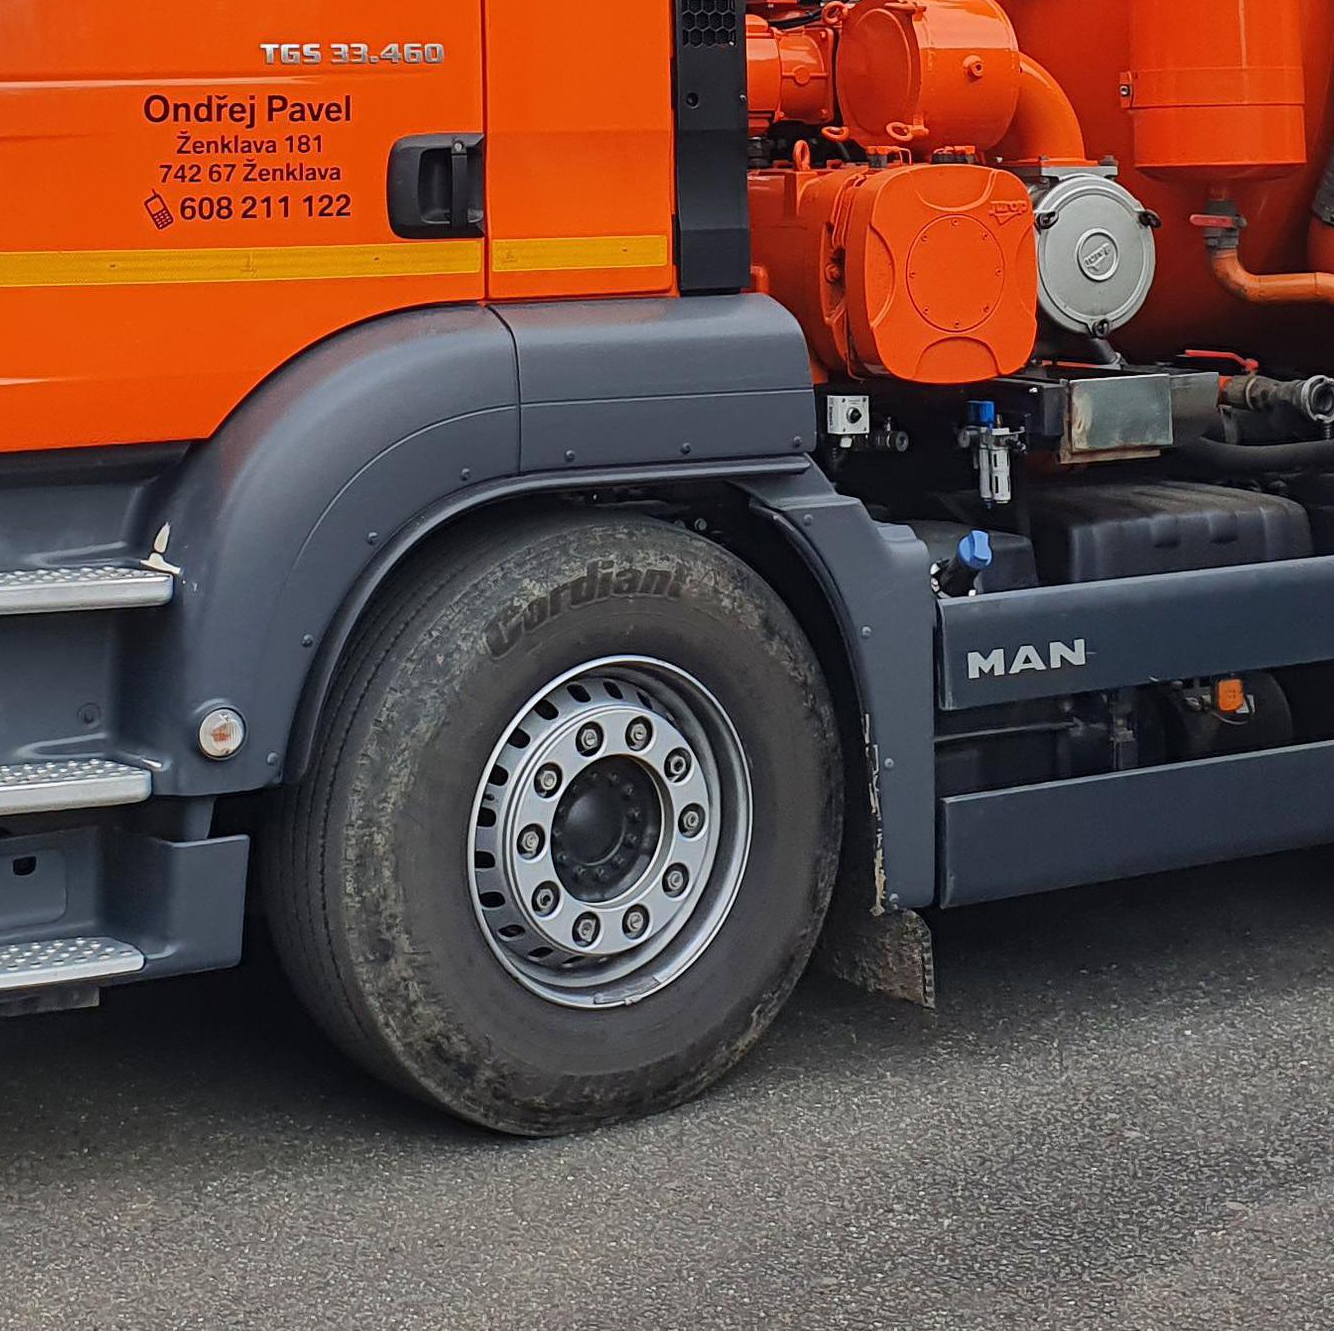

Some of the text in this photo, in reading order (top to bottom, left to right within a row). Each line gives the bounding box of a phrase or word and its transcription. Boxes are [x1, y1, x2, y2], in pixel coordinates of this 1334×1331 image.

[260, 42, 445, 64] TGS 33.460
[143, 94, 352, 129] Ondřej Pavel
[176, 131, 323, 155] Ženklava 181
[159, 159, 342, 184] 742 67 Ženklava
[180, 193, 352, 221] 608 211 122
[967, 638, 1086, 679] MAN
